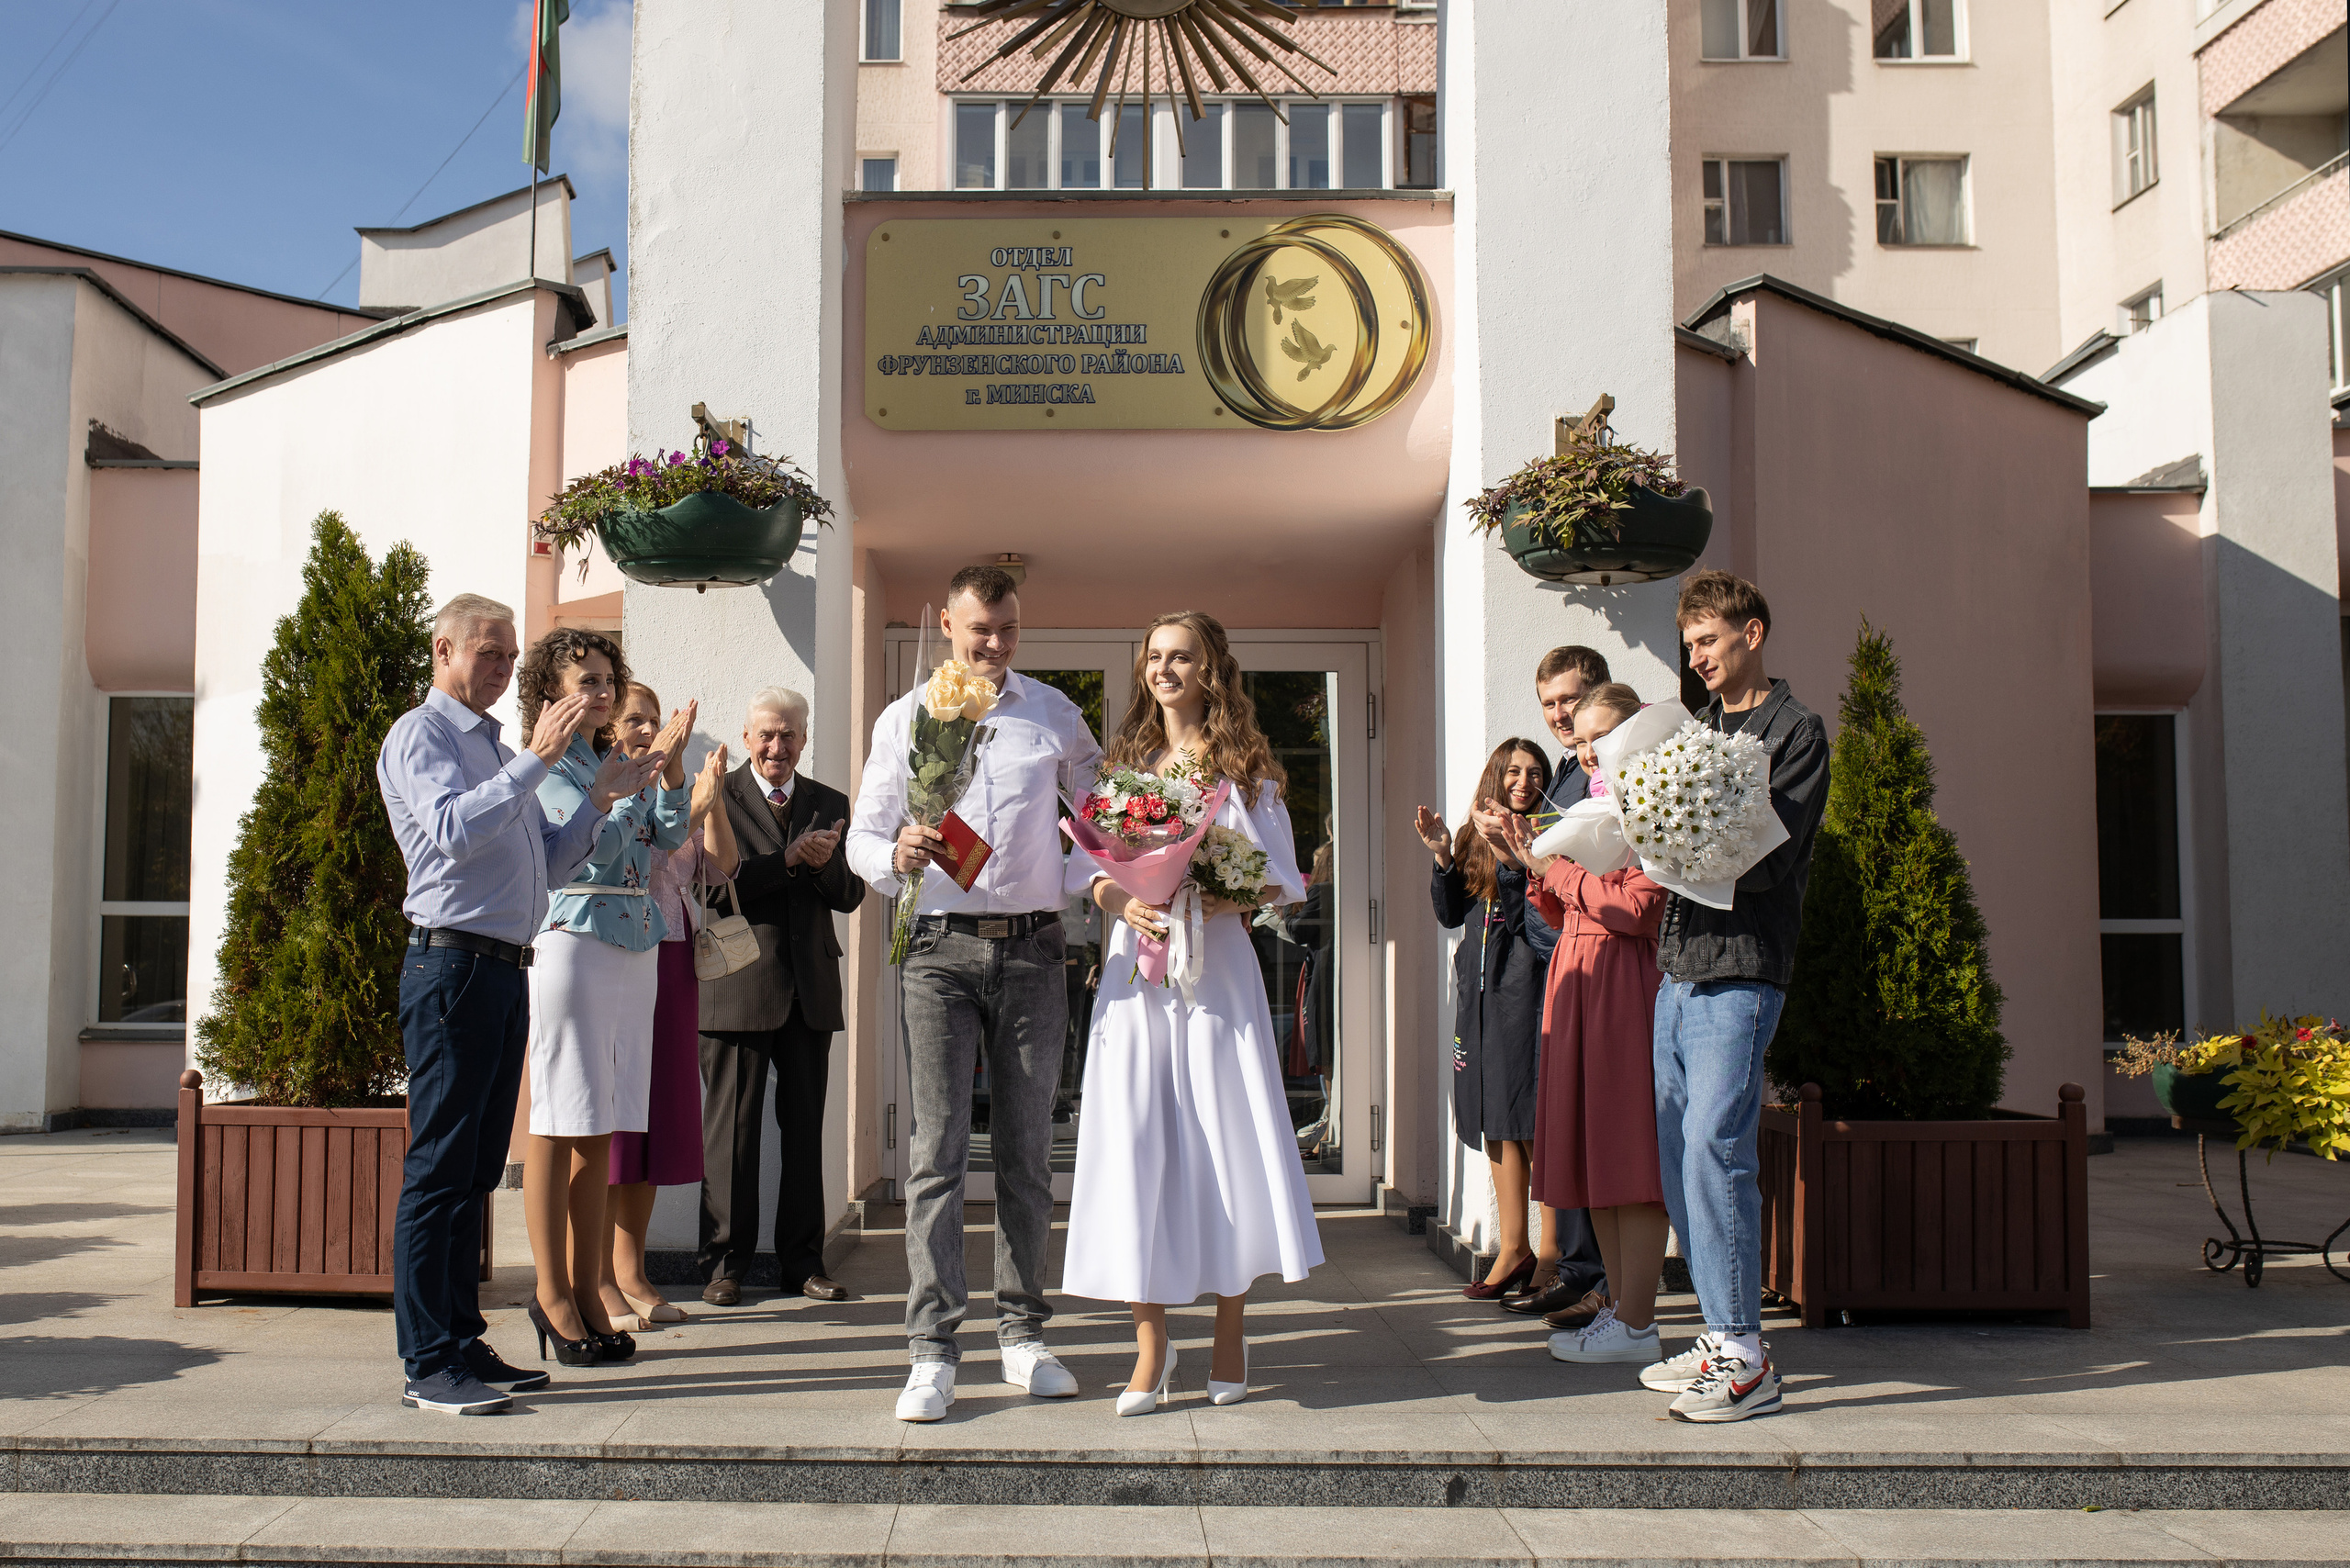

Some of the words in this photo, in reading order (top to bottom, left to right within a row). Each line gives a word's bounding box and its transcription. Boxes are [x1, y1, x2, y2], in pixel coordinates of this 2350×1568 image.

[990, 247, 1073, 271] ОТДЕЛ
[957, 274, 1105, 320] ЗАГС
[916, 324, 1147, 350] АДМИНИСТРАЦИИ
[878, 354, 1076, 375] ФРУНЗЕНСКОГО
[1081, 349, 1185, 374] РАЙОНА
[966, 389, 981, 404] г.
[986, 384, 1096, 404] МИНСКА
